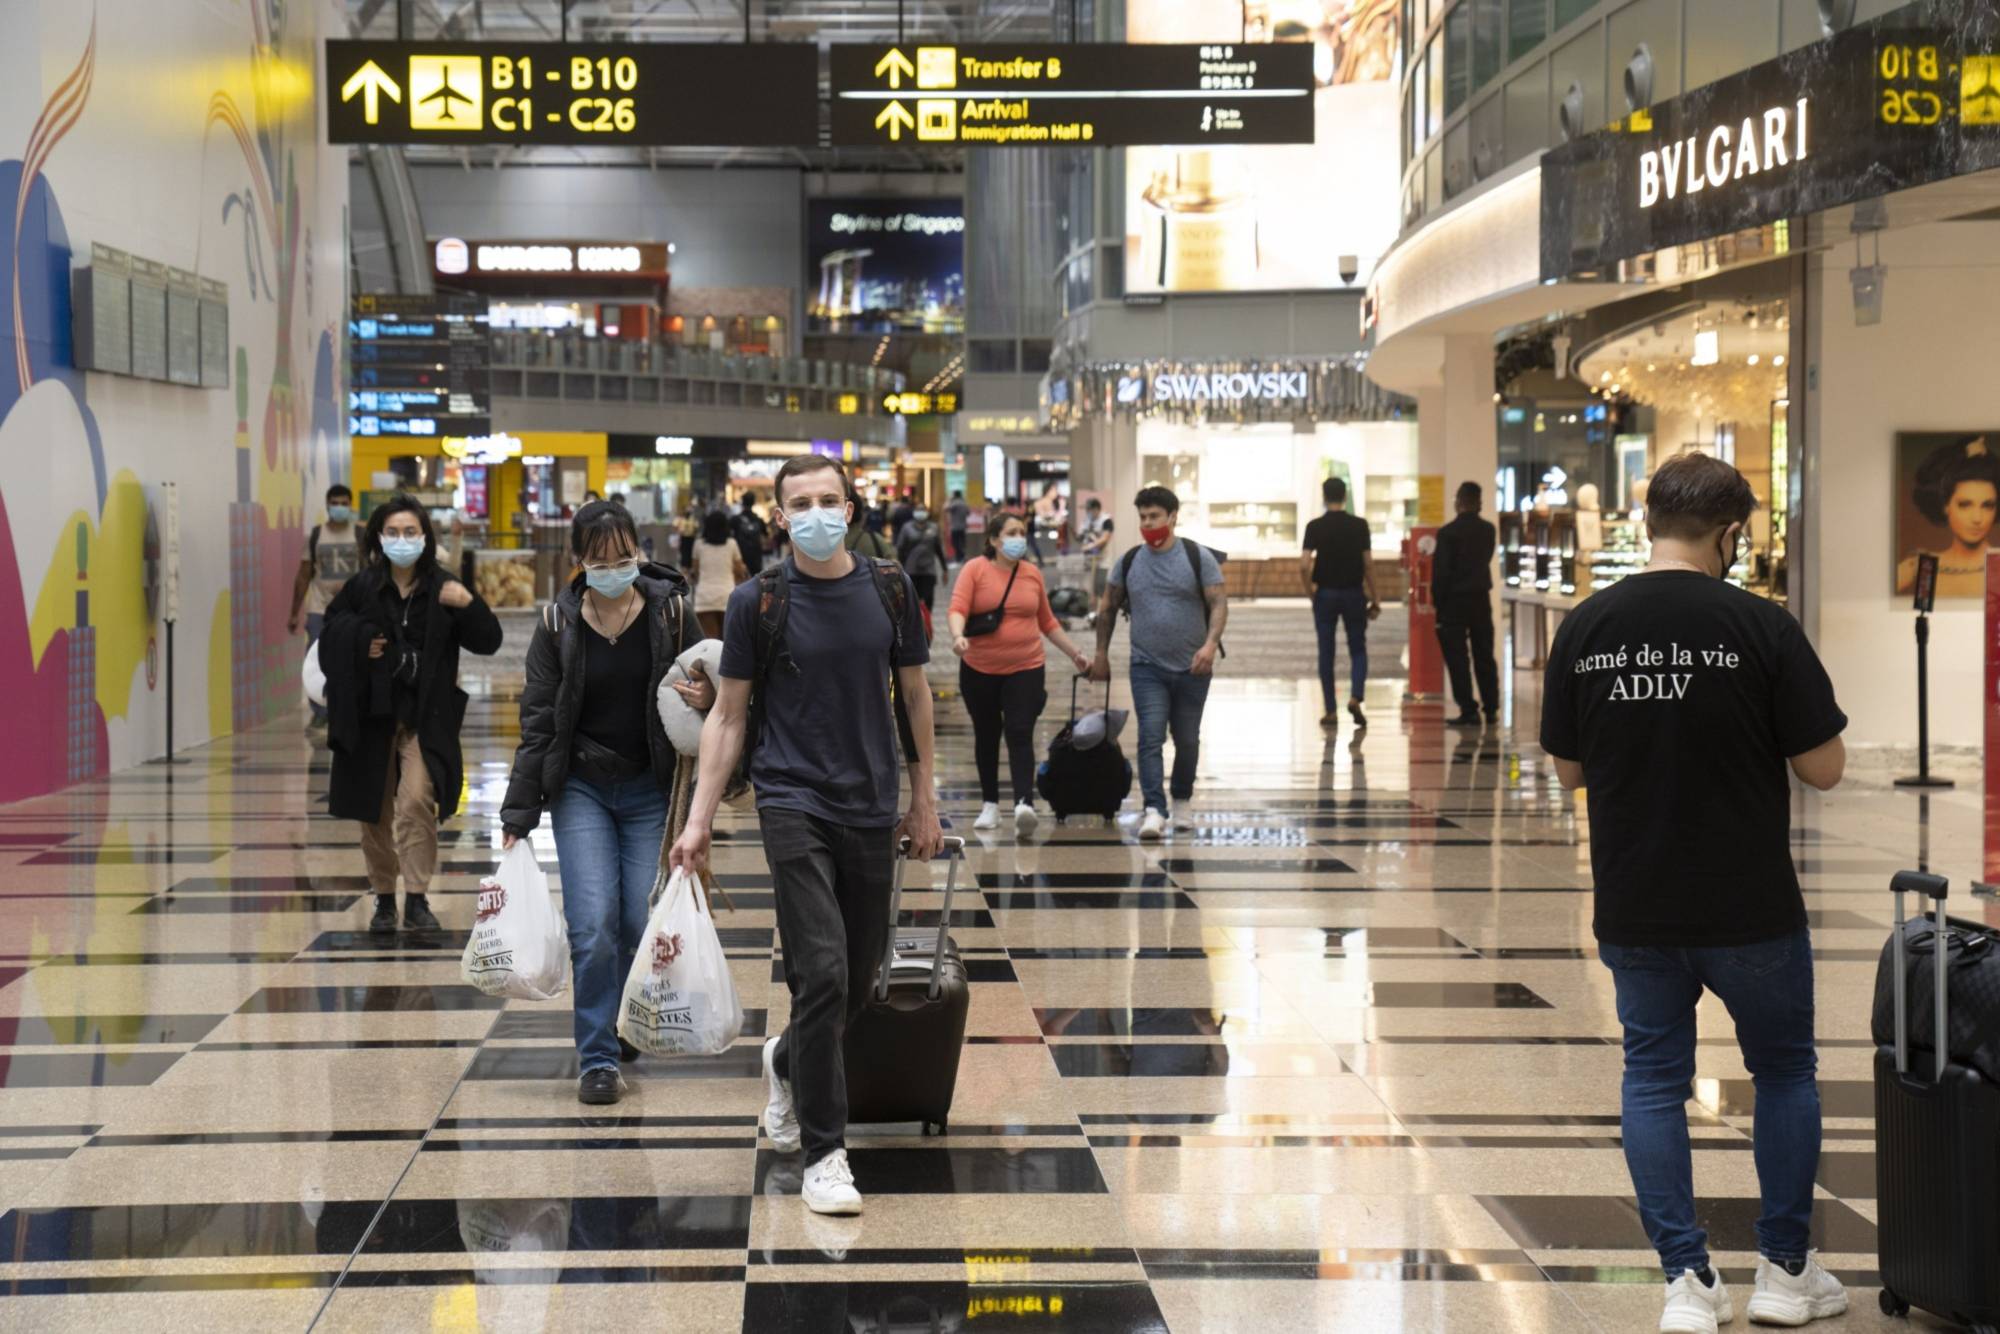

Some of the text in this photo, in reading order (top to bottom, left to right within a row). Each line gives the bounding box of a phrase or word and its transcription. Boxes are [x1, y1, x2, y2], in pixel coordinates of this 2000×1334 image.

[491, 56, 532, 90] B1
[571, 56, 638, 91] B10
[961, 57, 1061, 79] Transfer B
[491, 97, 532, 131] C1
[569, 98, 637, 132] C26
[961, 98, 1029, 120] Arrival
[961, 123, 1094, 143] Immigration Hall B
[1639, 97, 1808, 209] BVLGARI
[1154, 372, 1307, 400] SWAROVSKI
[1574, 643, 1740, 673] acmé de la vie
[1608, 673, 1693, 701] ADLV
[628, 1002, 693, 1025] BES ATES
